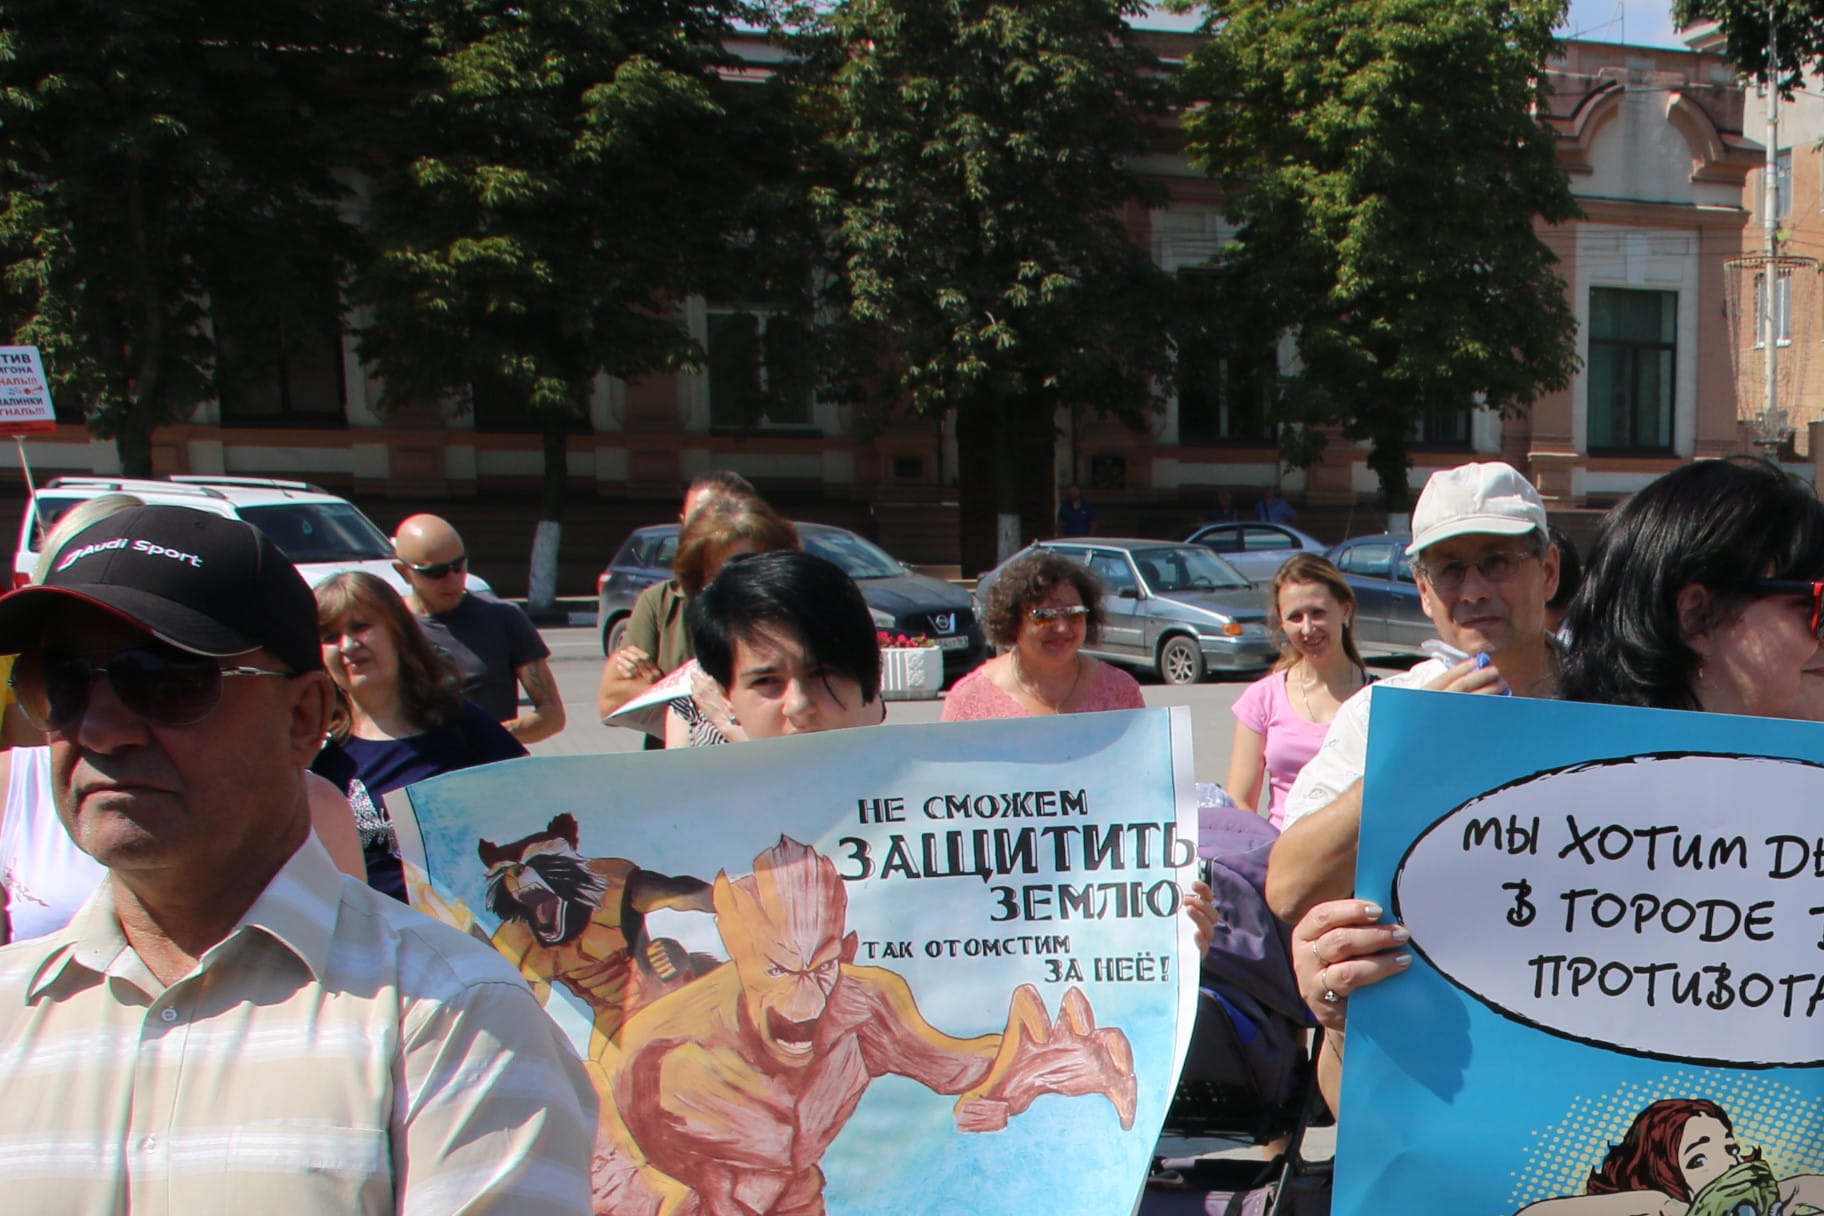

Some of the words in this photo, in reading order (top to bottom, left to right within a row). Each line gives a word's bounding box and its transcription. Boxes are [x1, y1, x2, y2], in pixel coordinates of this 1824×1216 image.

[132, 539, 204, 568] Sport
[858, 797, 906, 824] НЕ
[923, 789, 1089, 820] СМОЖЕМ
[838, 821, 1200, 883] ЗАЩИТИТЬ
[1462, 815, 1540, 856] МЫ
[1558, 814, 1748, 871] ХОТИМ
[989, 879, 1183, 922] ЗЕМЛЮ
[1501, 878, 1537, 927] В
[1560, 888, 1775, 943] ГОРОДЕ
[863, 938, 914, 959] ТАК
[925, 934, 1071, 957] ОТОМСТИМ
[1044, 958, 1084, 983] ЗА
[1094, 952, 1171, 983] НЕЁ!
